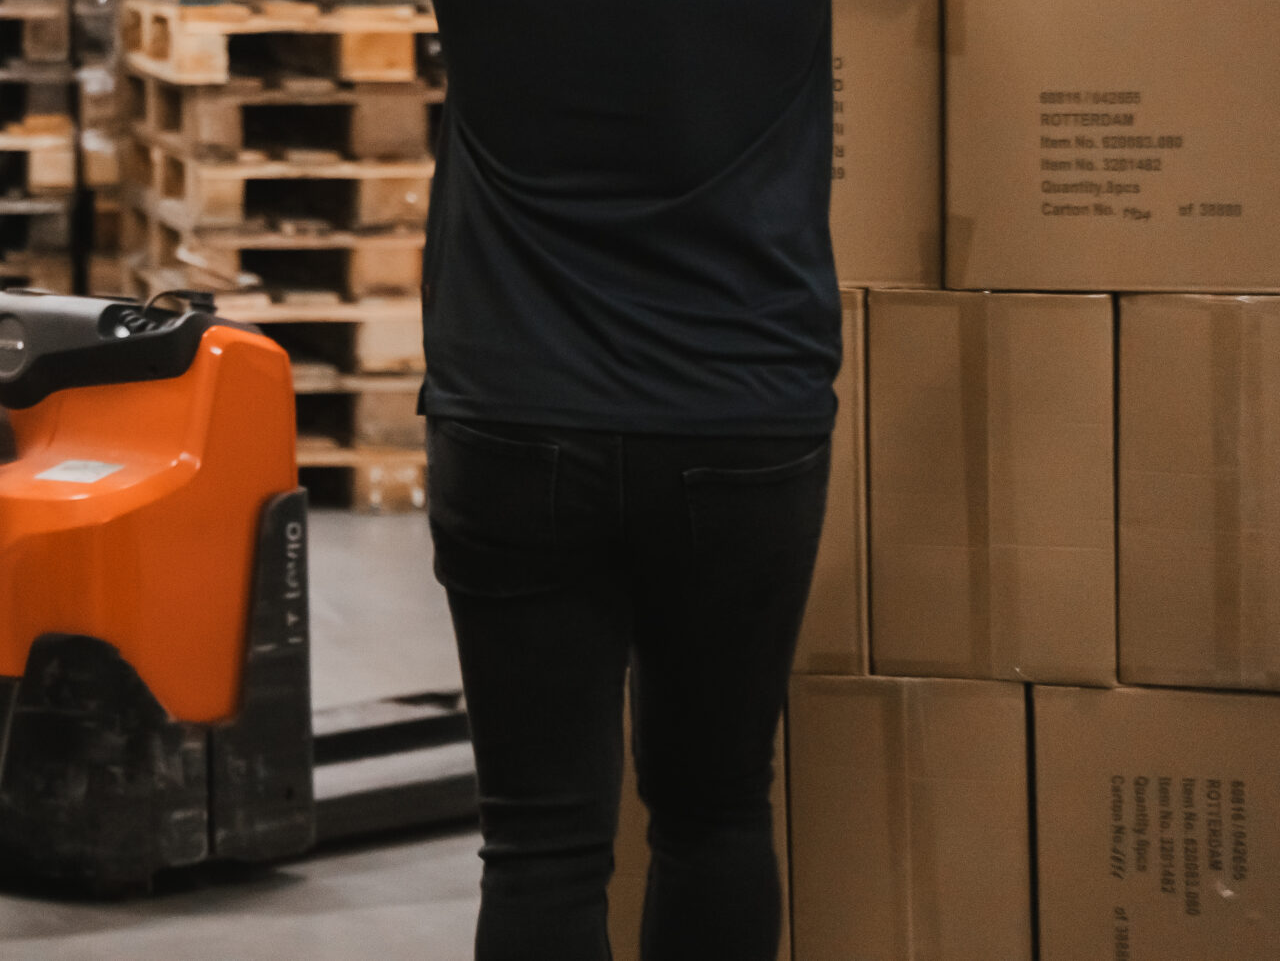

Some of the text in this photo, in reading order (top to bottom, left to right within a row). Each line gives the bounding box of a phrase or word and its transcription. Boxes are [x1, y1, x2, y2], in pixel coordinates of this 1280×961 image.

[1040, 112, 1134, 127] ROTTERDAM
[1040, 136, 1072, 149] Item
[1040, 158, 1072, 171] Item
[1041, 202, 1089, 216] Carton
[1178, 202, 1193, 216] of
[1111, 775, 1125, 822] Carton
[1158, 776, 1172, 808] Item
[1182, 777, 1196, 808] Item
[1207, 779, 1223, 871] ROTTERDAM
[1114, 906, 1128, 922] of
